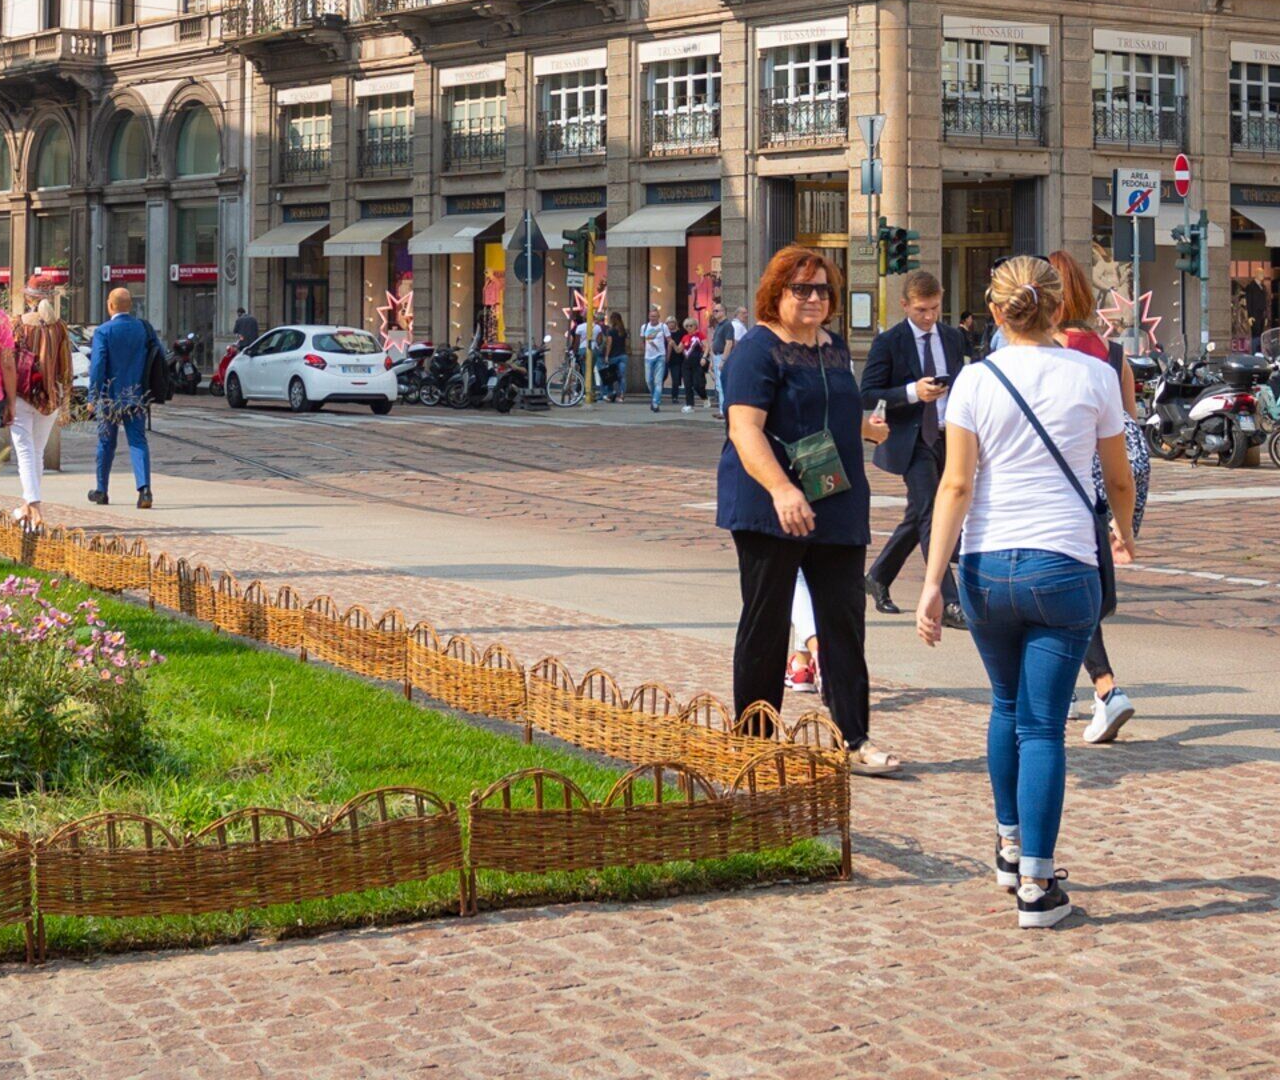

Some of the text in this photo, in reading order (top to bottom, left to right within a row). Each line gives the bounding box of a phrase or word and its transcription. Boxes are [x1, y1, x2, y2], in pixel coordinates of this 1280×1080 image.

[970, 23, 1025, 41] TRUSSARDI
[1117, 36, 1169, 52] TRUSSARDI
[1130, 172, 1150, 181] AREA
[1121, 180, 1158, 190] PEDONALE
